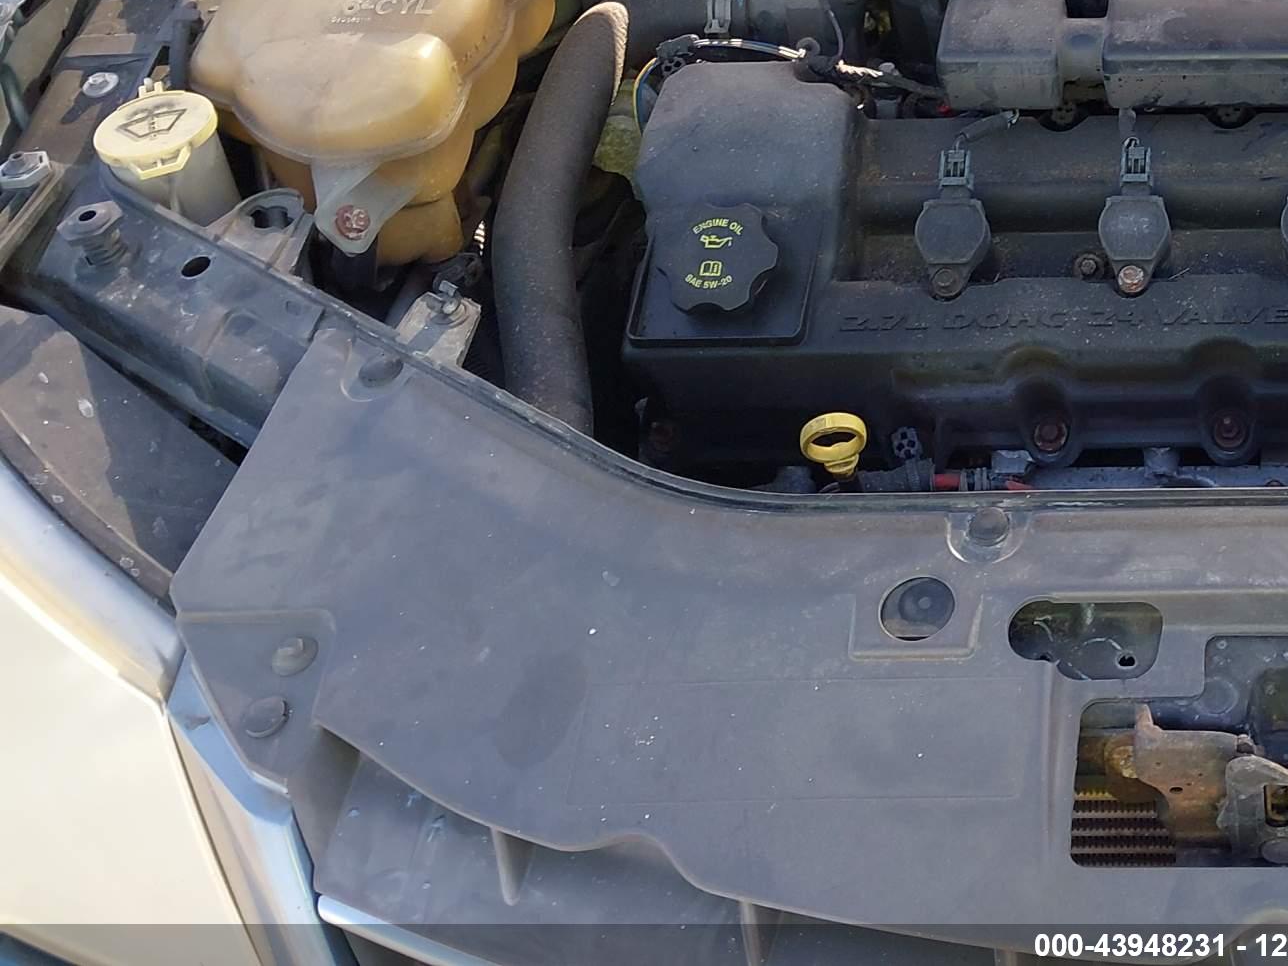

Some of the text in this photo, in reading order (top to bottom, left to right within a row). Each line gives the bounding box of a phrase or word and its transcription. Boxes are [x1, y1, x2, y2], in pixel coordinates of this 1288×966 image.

[692, 218, 744, 235] ENGINE OIL
[685, 274, 733, 289] SAE 5W-20
[943, 310, 1067, 330] DOHC
[1086, 309, 1143, 327] 24
